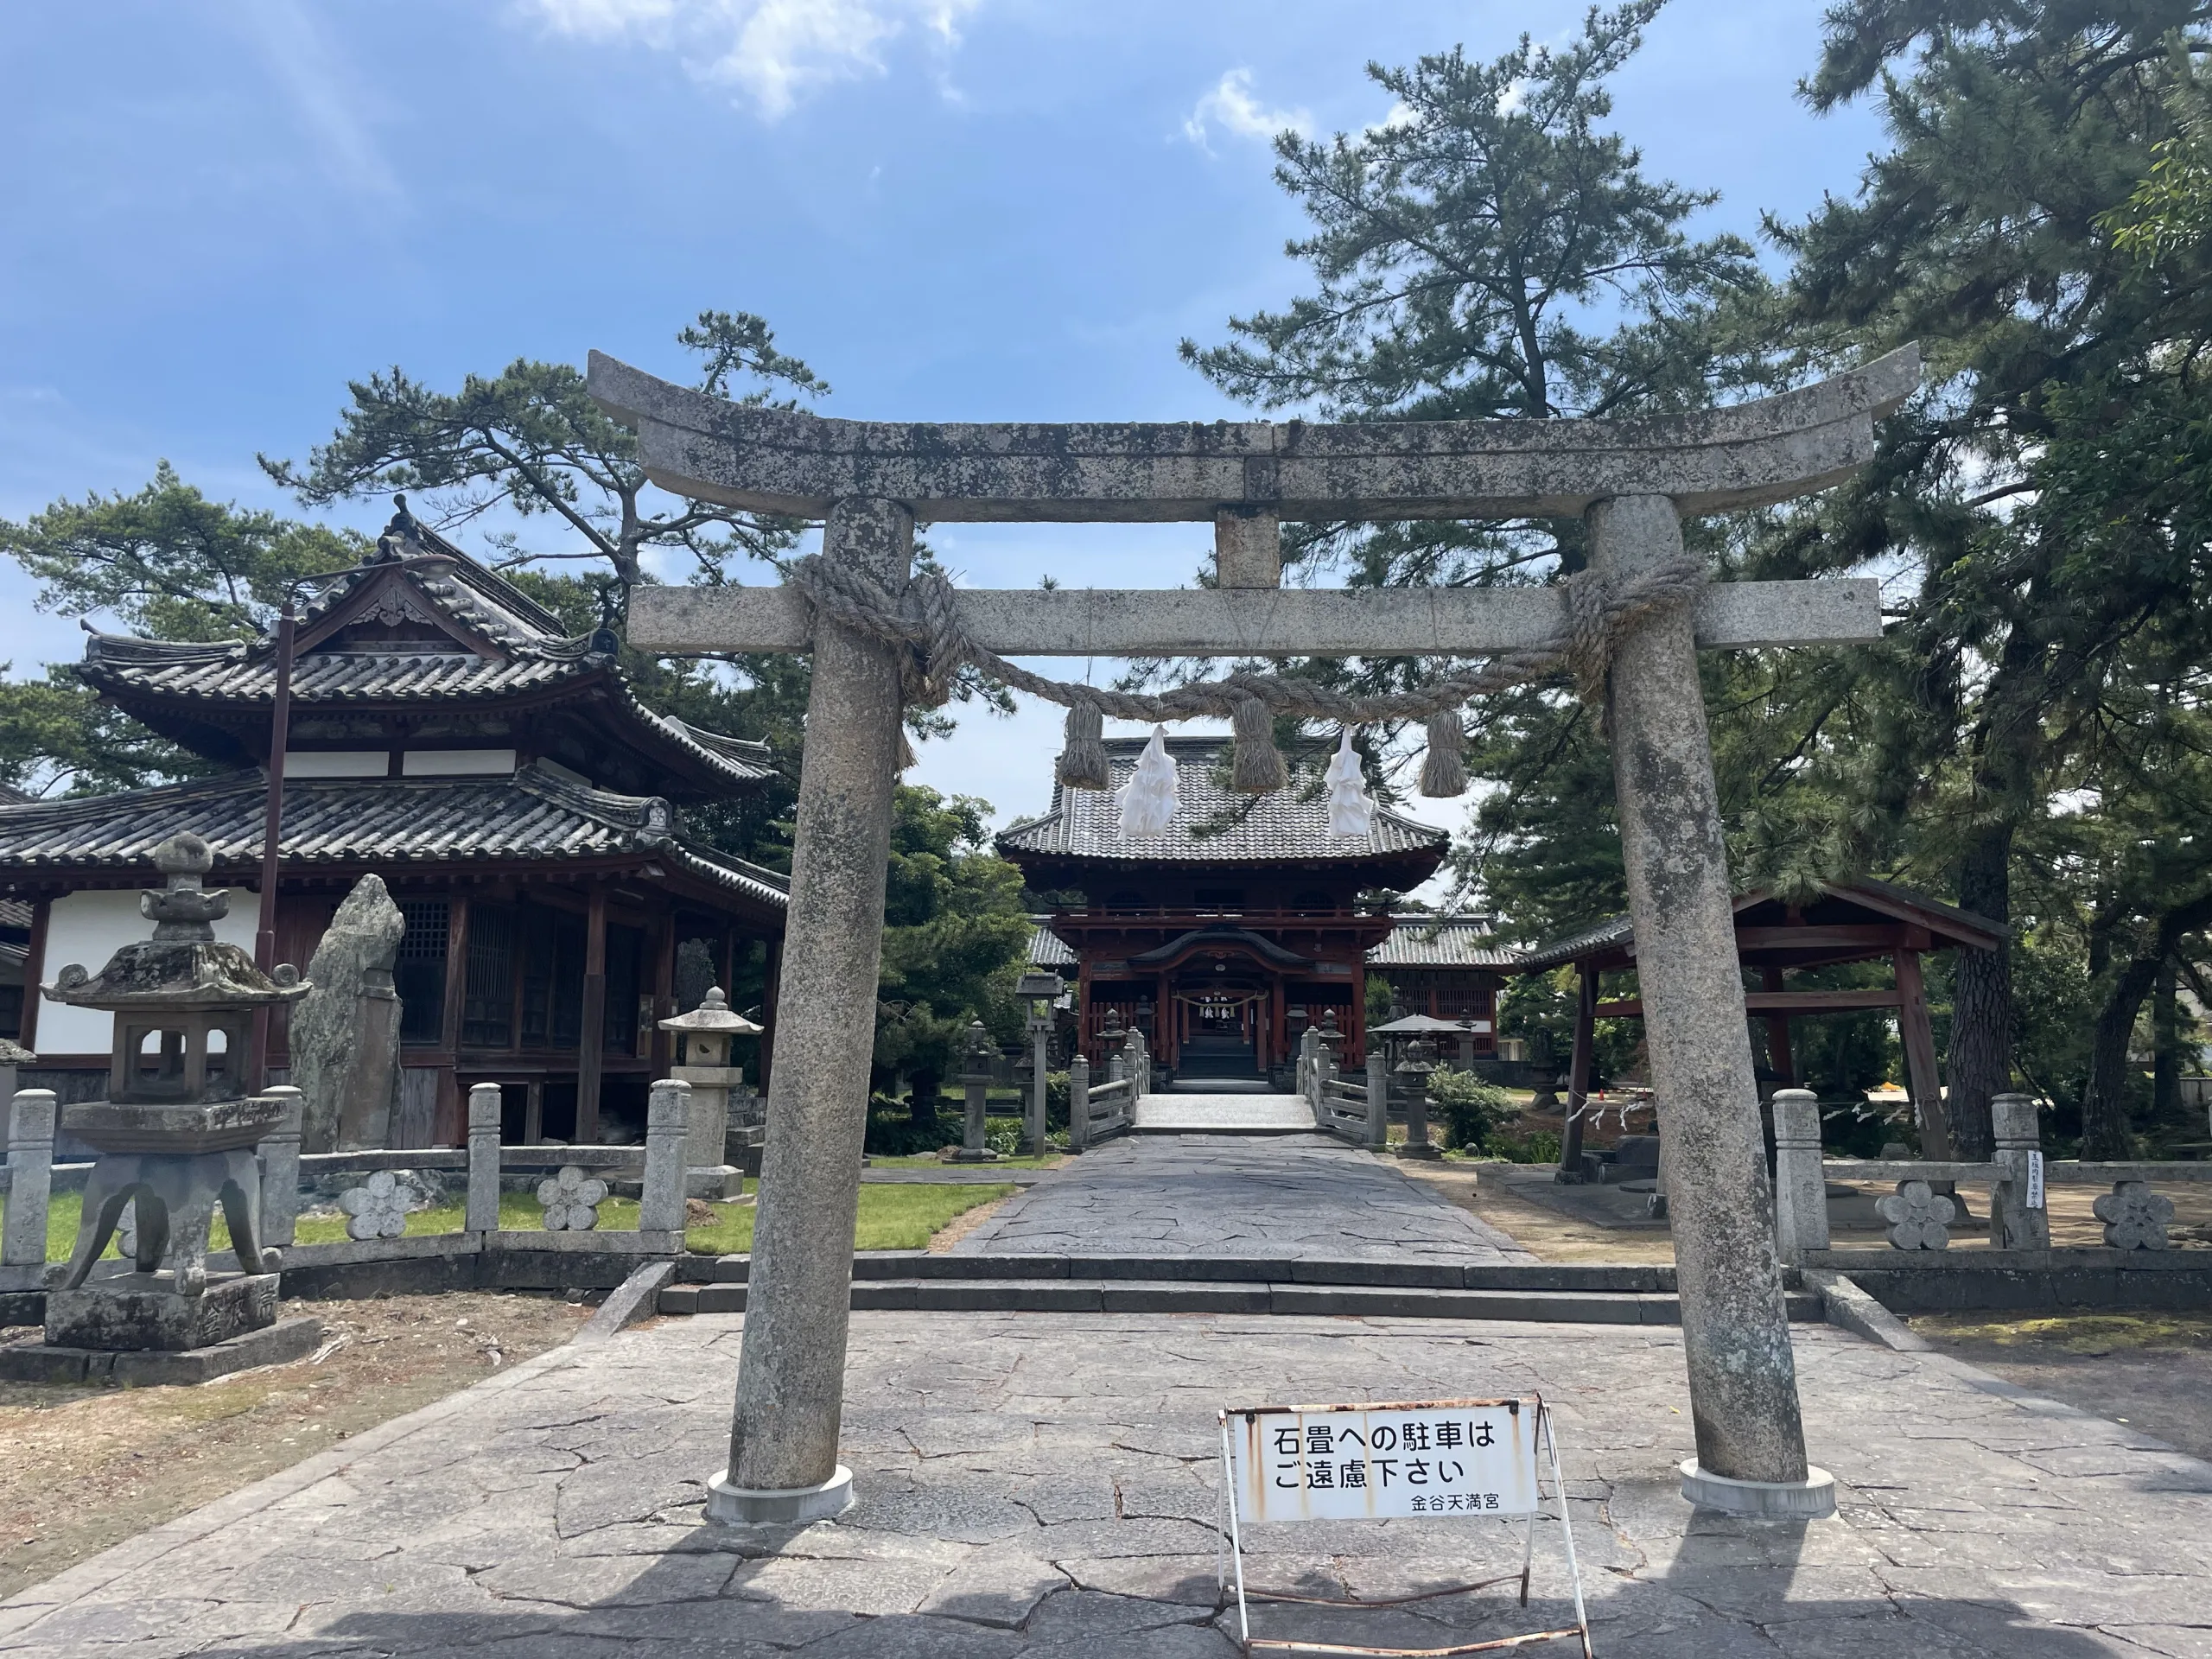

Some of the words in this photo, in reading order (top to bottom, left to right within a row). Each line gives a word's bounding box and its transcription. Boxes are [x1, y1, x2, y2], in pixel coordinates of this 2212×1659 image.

[1274, 1421, 1495, 1455] 石畳への駐車は
[1275, 1458, 1464, 1489] ご遠慮下さい
[1411, 1493, 1499, 1511] 金谷天満宮
